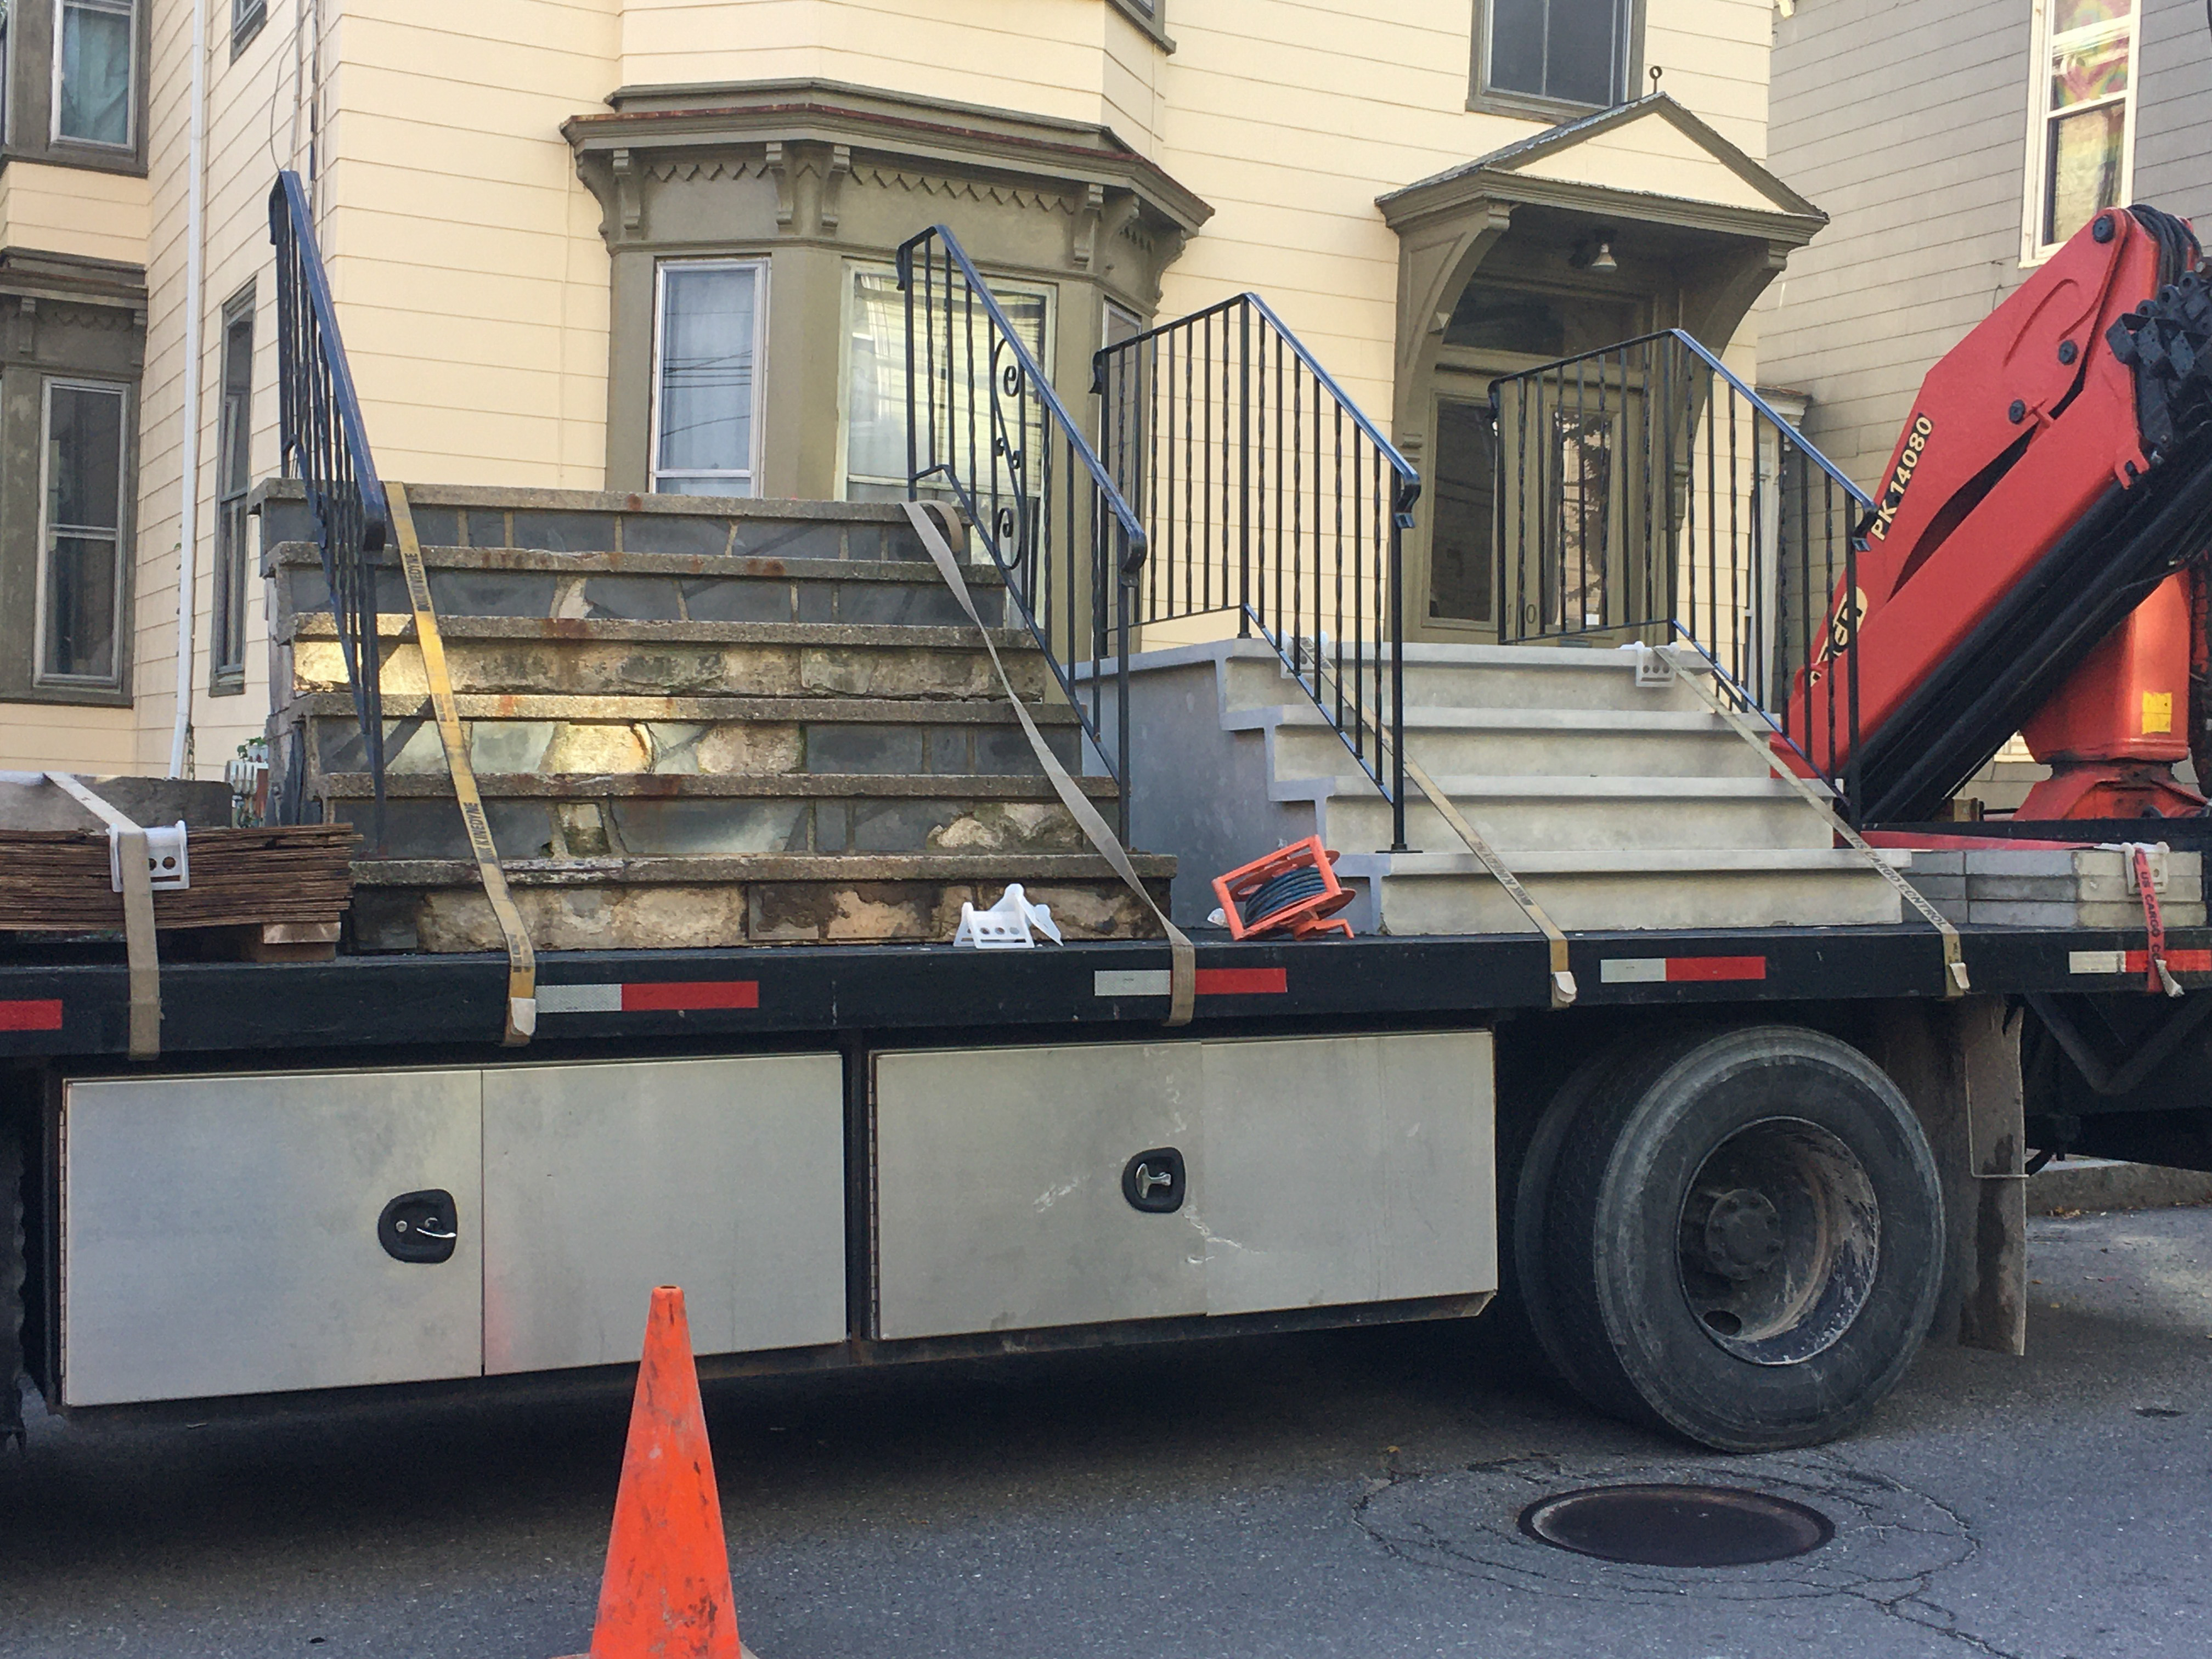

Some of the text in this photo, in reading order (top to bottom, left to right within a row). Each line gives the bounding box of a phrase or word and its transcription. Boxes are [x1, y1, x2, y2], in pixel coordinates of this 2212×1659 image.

[1871, 417, 1932, 541] PK 14080
[464, 802, 490, 845] KINEDYNE
[1865, 851, 1900, 883] CARGO
[1898, 883, 1948, 927] CONTROL
[2141, 871, 2151, 888] US
[2145, 894, 2160, 938] CARGO
